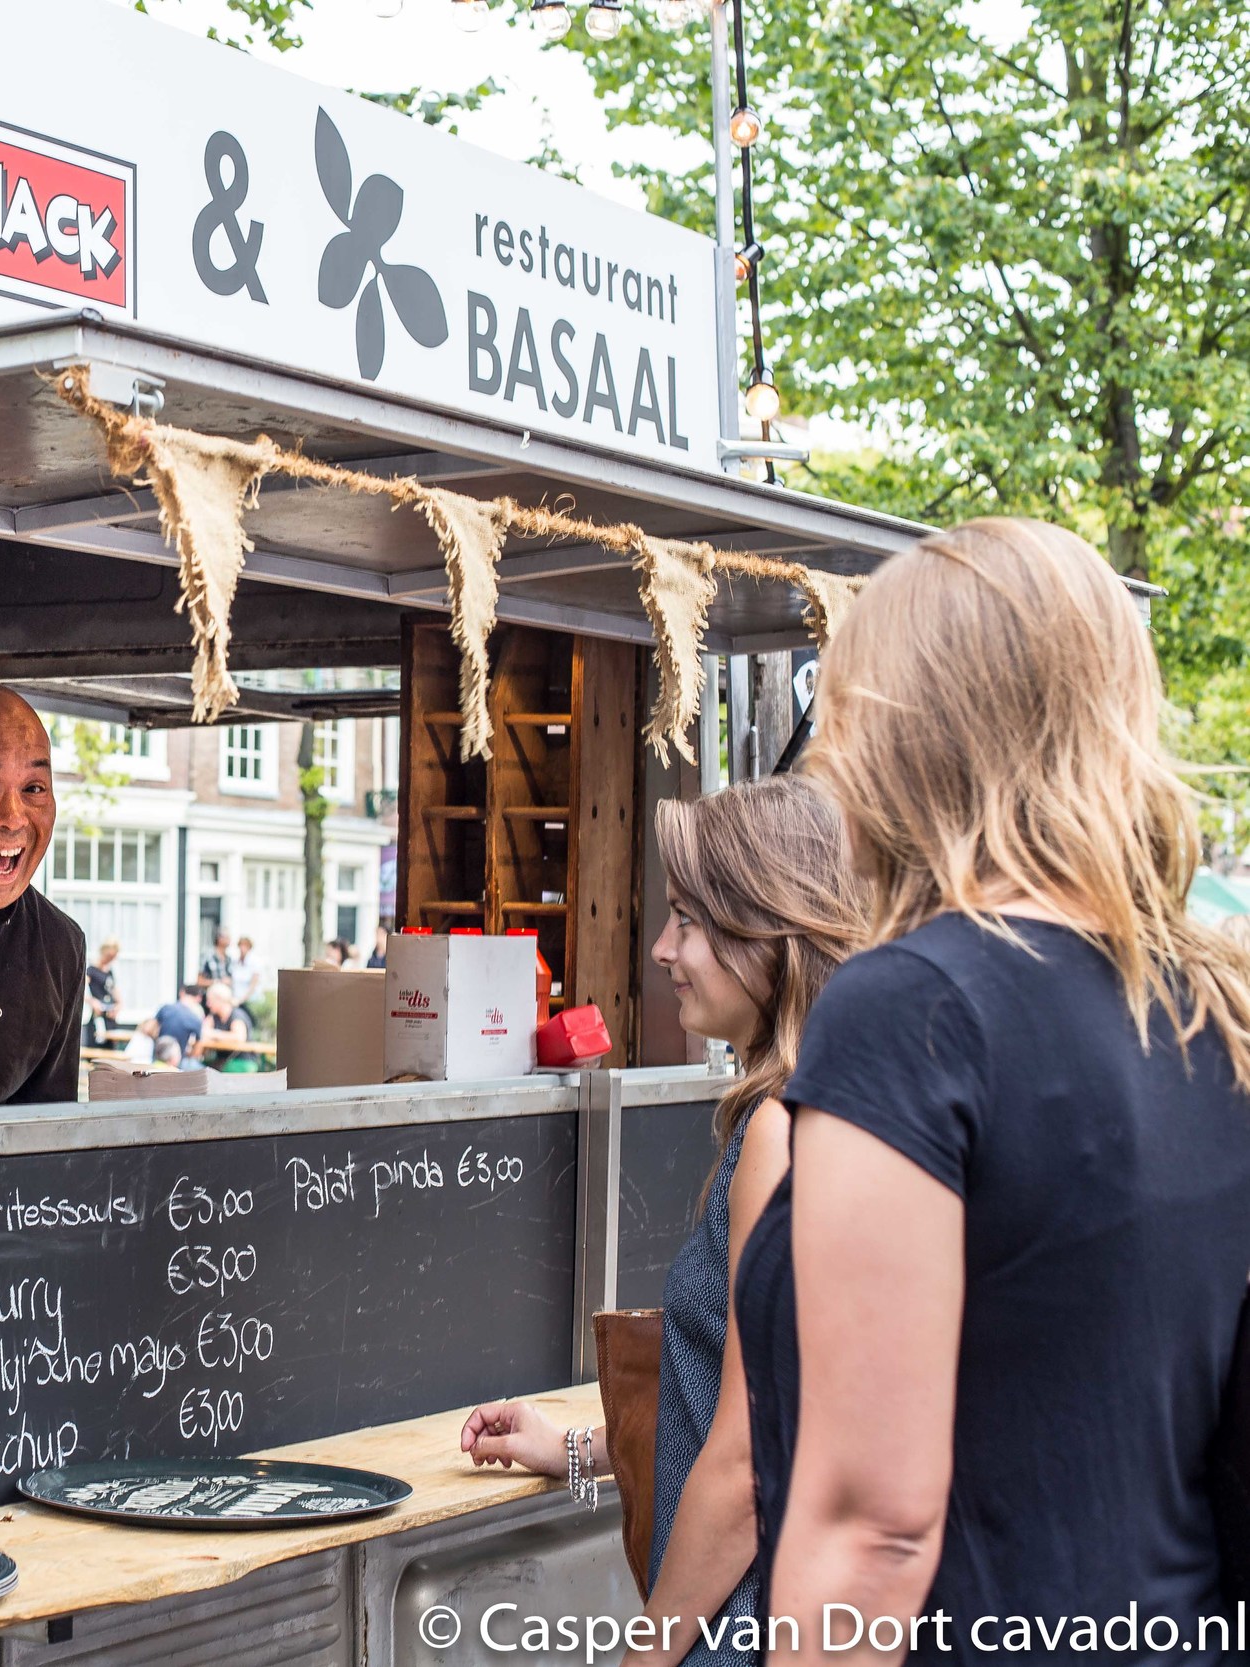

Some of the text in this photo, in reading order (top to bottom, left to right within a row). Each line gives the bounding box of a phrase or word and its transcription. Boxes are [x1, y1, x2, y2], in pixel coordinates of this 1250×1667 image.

[192, 131, 269, 305] &
[475, 212, 678, 324] restaurant
[467, 290, 689, 450] BASAAL
[168, 1176, 254, 1231] €3,00
[284, 1145, 524, 1219] Patat pinda €3,00
[167, 1244, 257, 1297] €3,00
[110, 1335, 186, 1399] mayo
[197, 1311, 274, 1373] €3,00
[178, 1387, 244, 1448] €3,00
